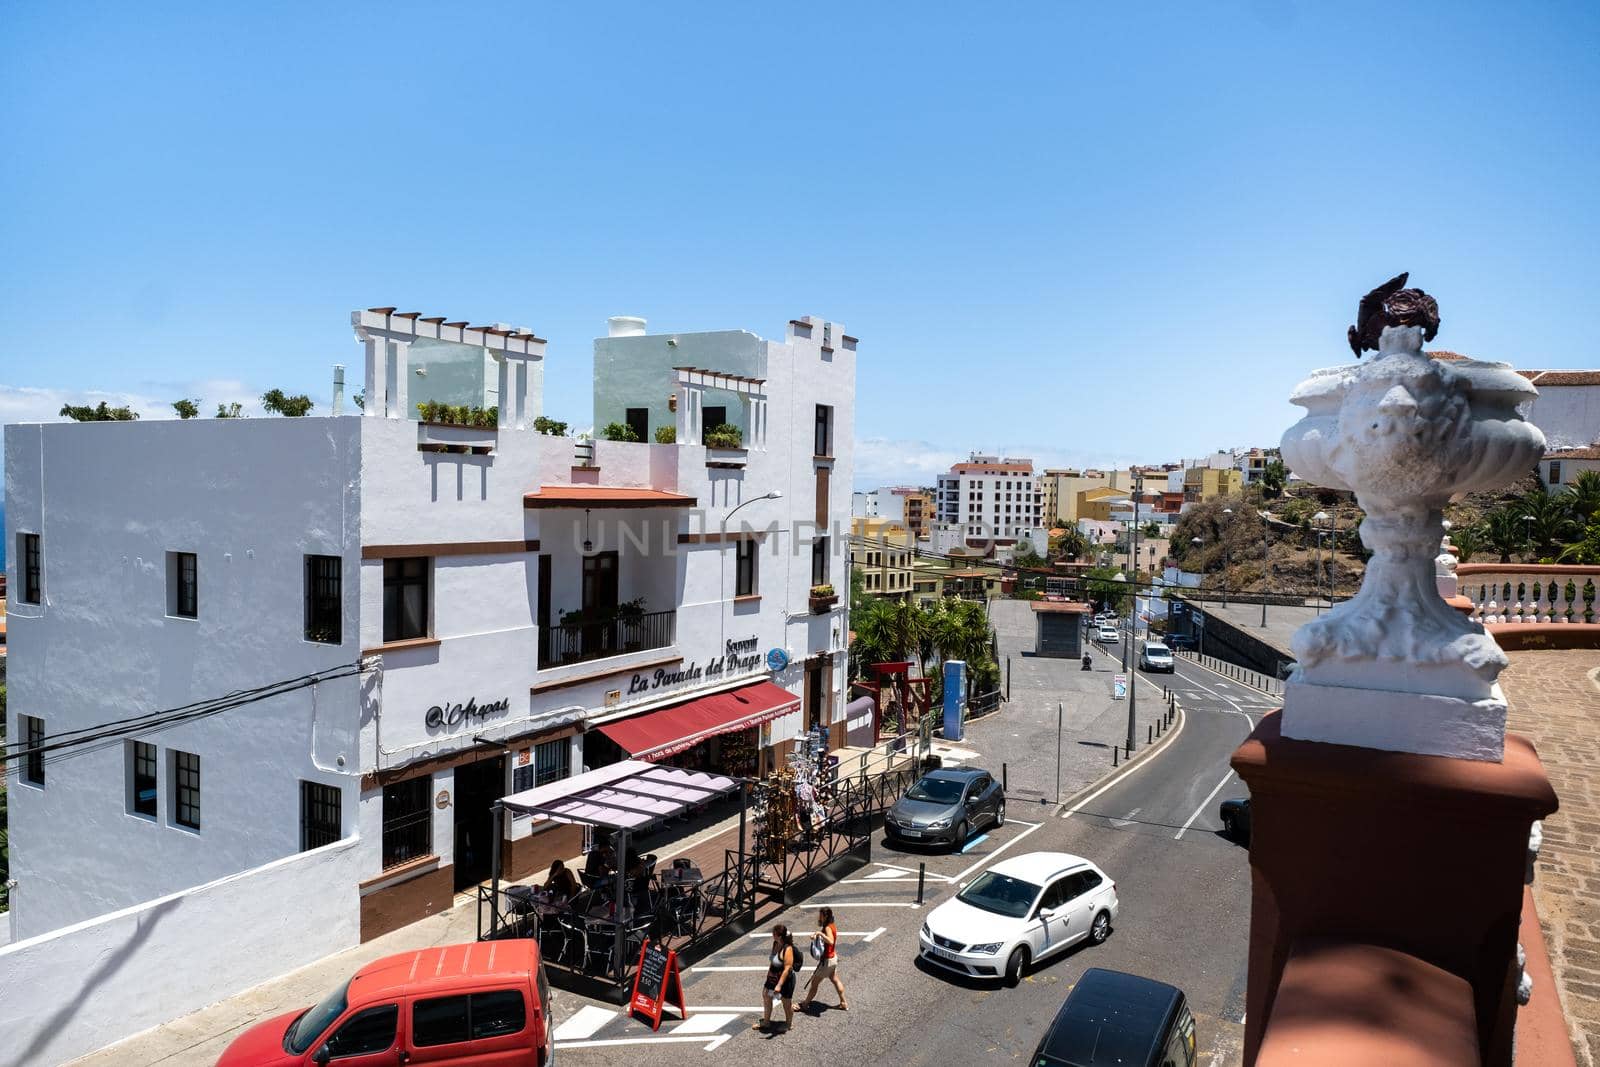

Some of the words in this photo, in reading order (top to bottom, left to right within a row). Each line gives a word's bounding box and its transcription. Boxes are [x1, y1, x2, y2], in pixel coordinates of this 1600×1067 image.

[726, 635, 759, 653] Souvenir
[627, 674, 649, 696] La
[652, 661, 702, 690] Parada
[705, 656, 725, 676] del
[726, 652, 761, 673] Drago
